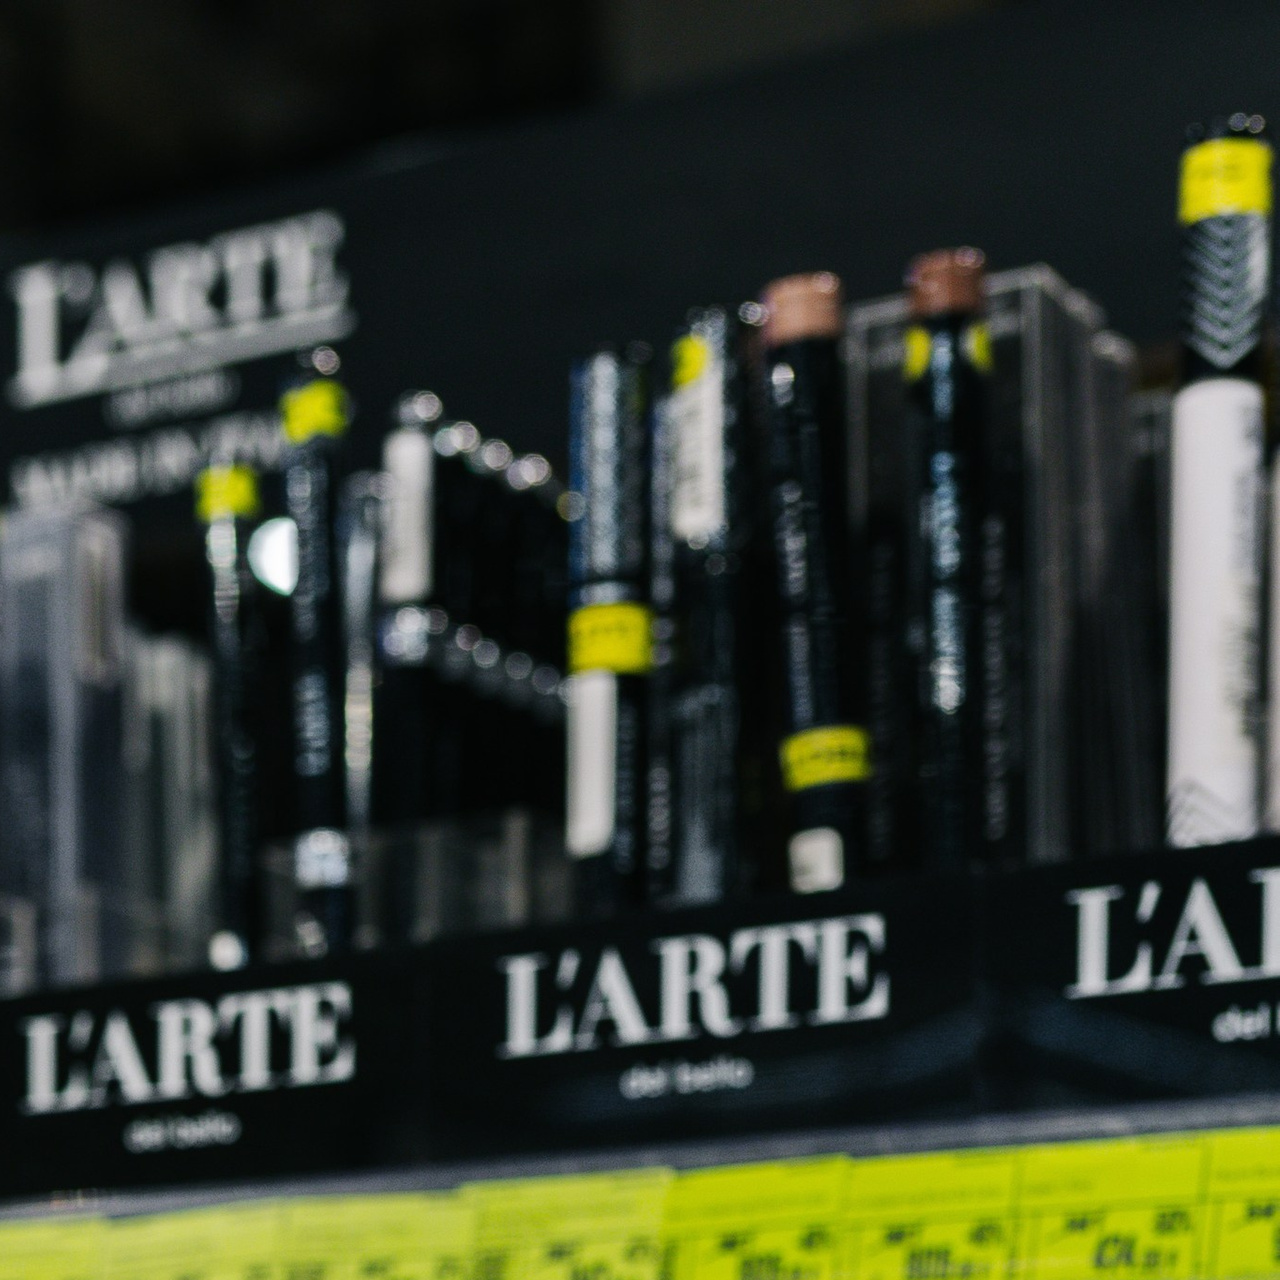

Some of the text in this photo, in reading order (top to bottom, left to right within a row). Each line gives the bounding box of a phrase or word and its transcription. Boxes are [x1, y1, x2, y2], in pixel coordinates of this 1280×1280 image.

[12, 209, 354, 405] L'ARTE
[22, 981, 356, 1114] L'ARTE
[499, 914, 890, 1060] L'ARTE
